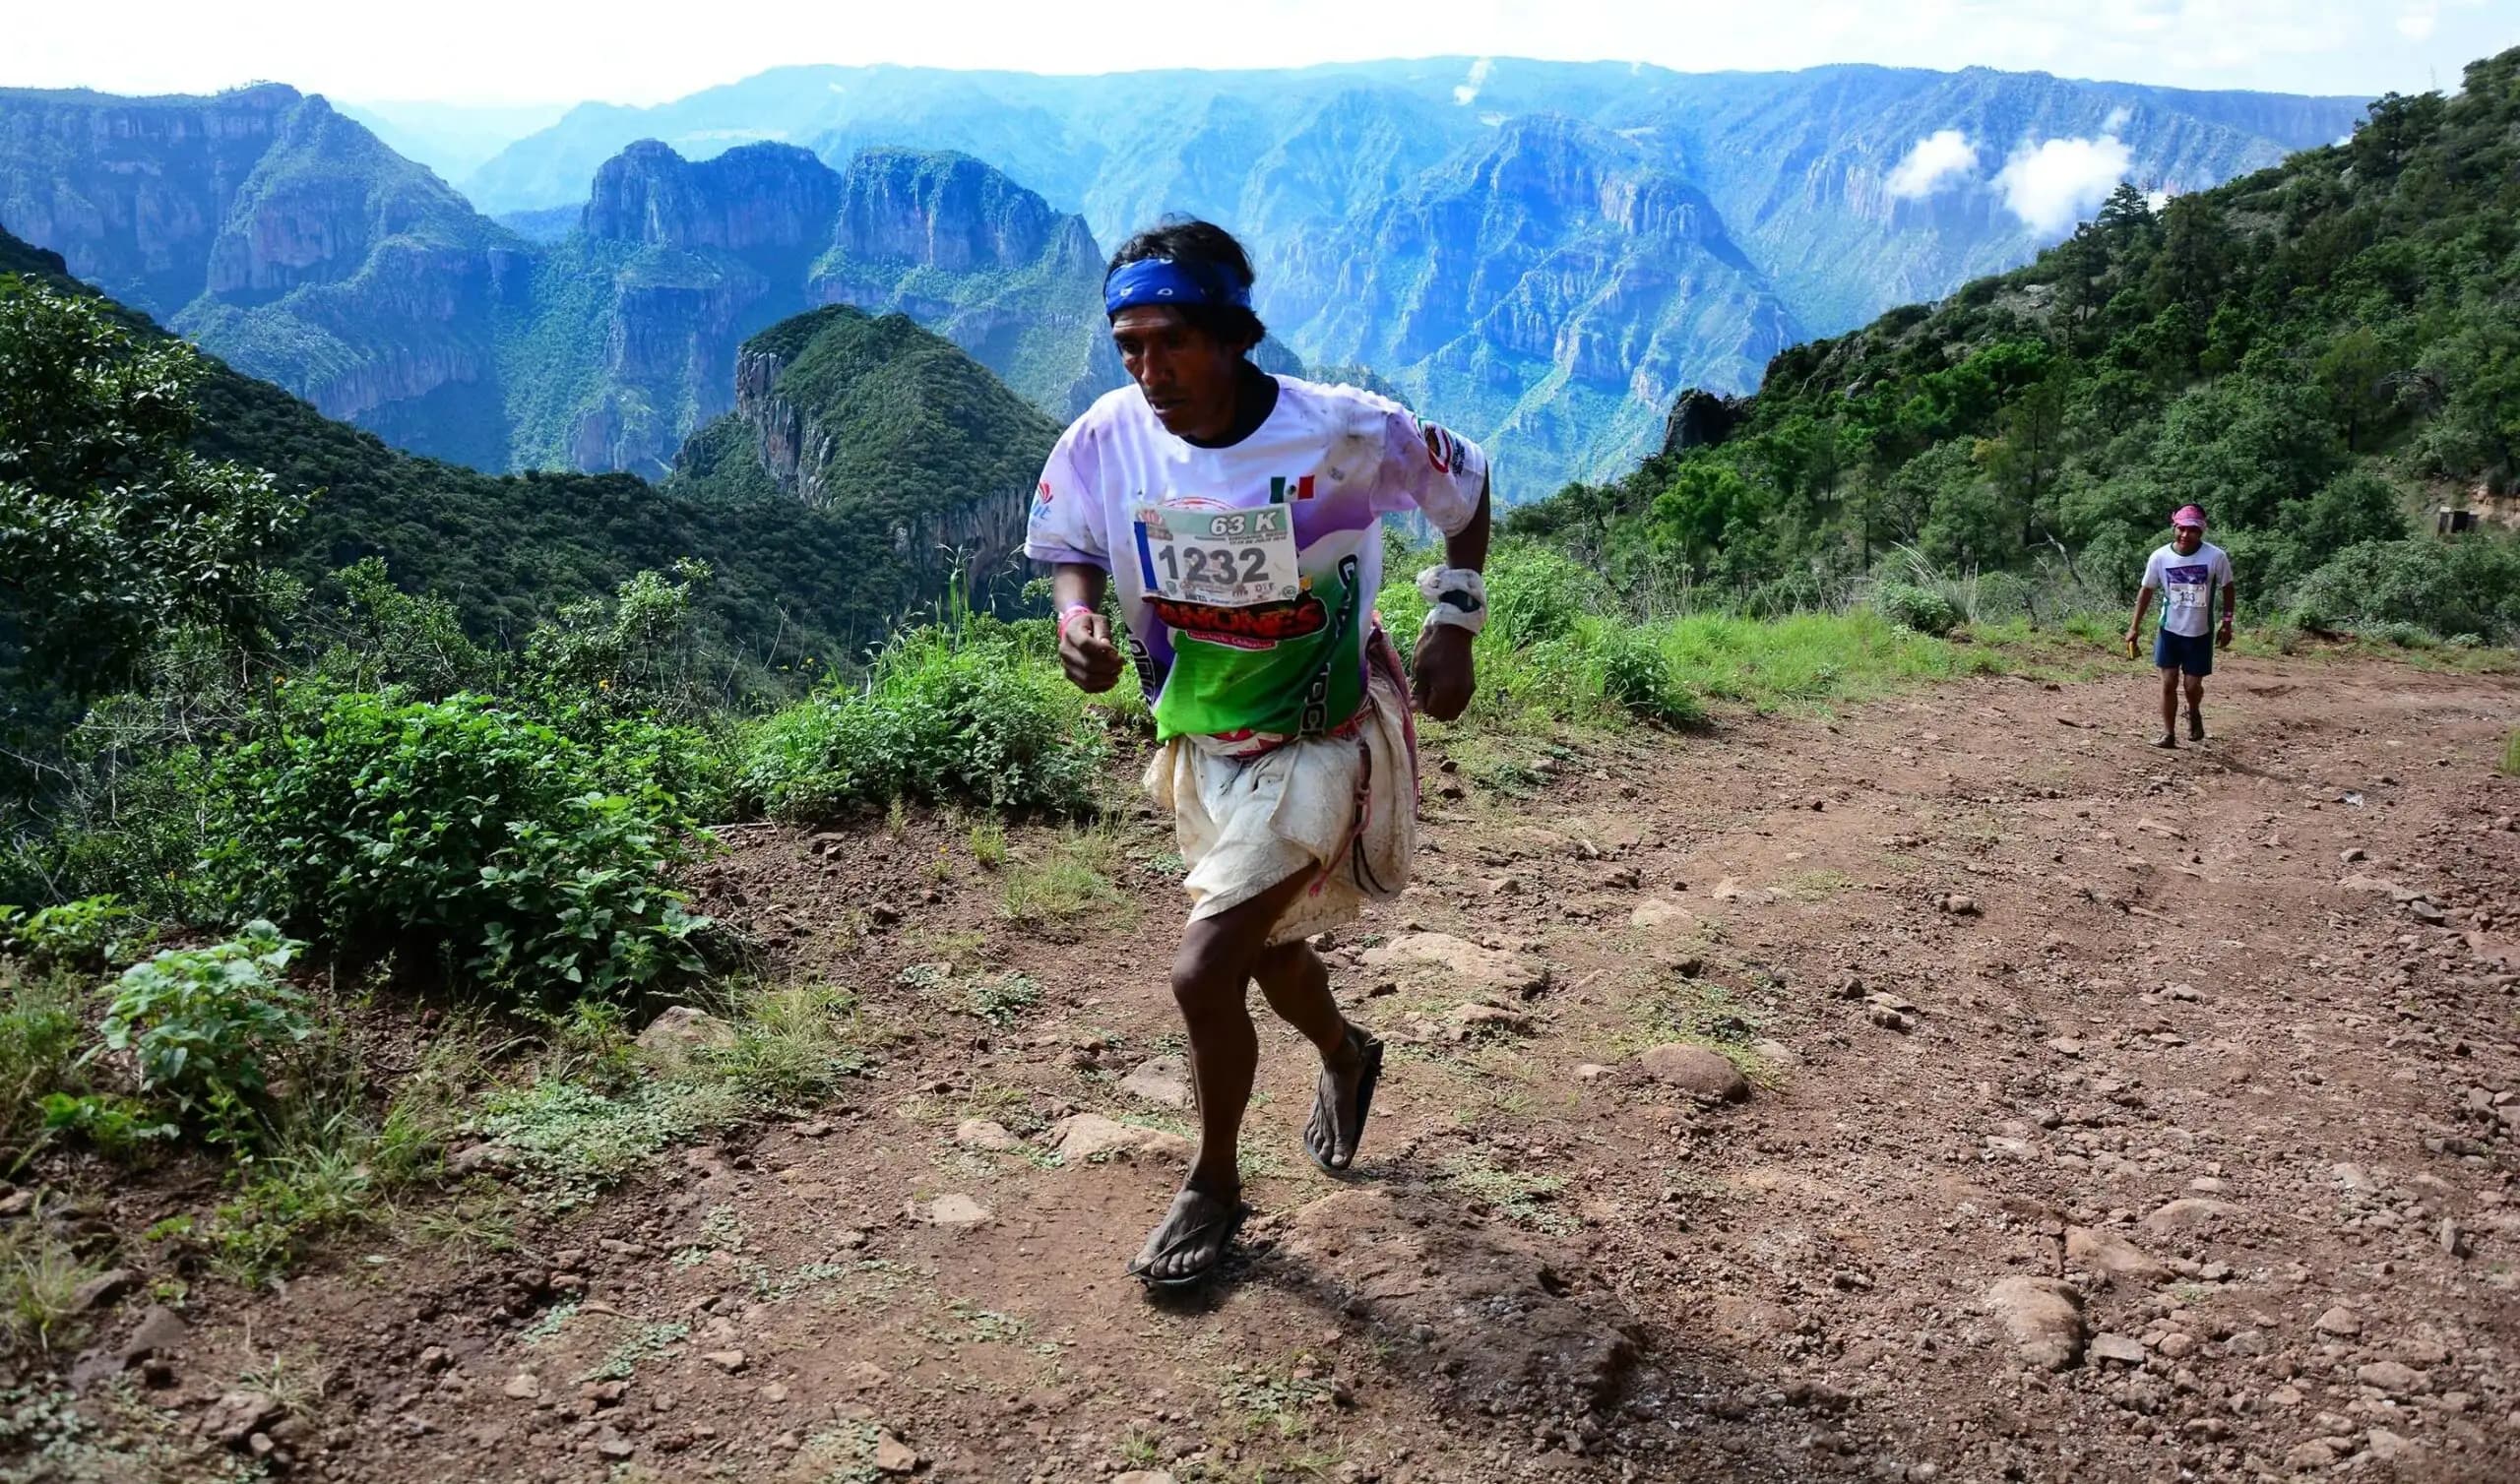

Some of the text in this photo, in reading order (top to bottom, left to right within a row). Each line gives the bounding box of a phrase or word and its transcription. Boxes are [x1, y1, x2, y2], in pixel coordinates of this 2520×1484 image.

[1210, 514, 1245, 536] 63
[1253, 511, 1278, 532] K
[1158, 544, 1270, 586] 1232
